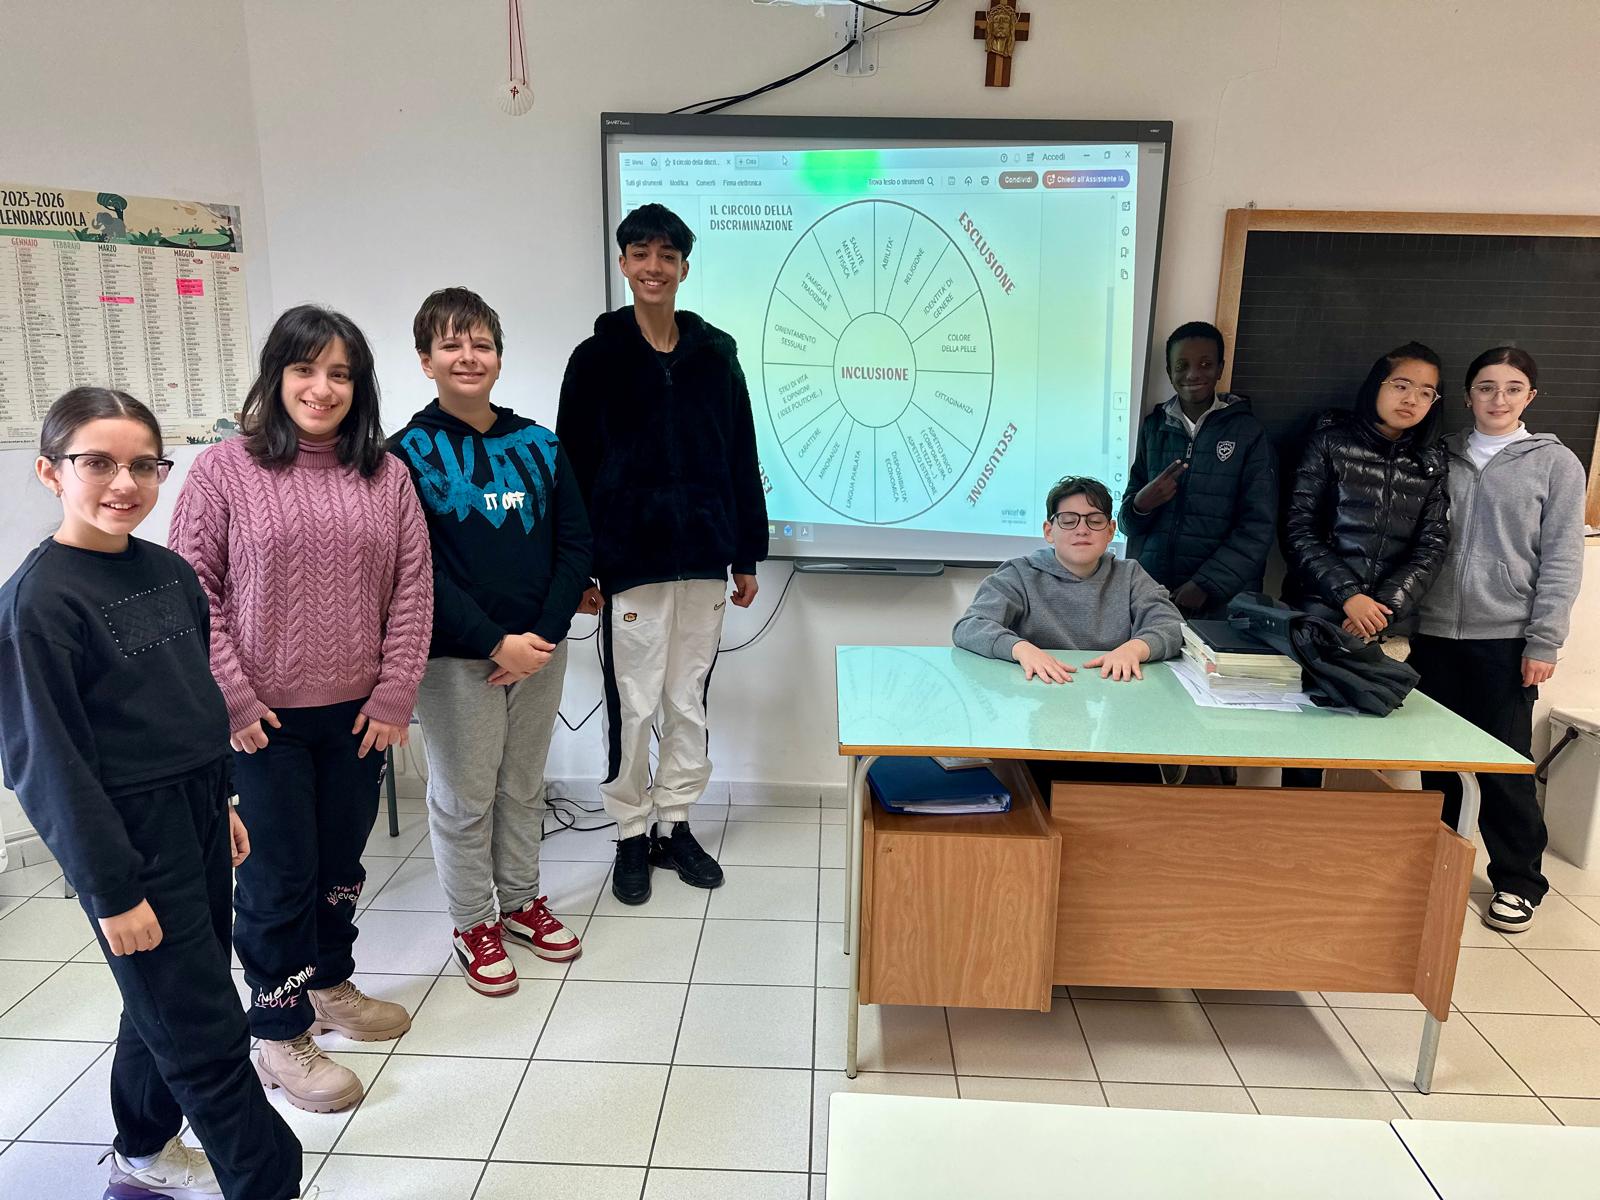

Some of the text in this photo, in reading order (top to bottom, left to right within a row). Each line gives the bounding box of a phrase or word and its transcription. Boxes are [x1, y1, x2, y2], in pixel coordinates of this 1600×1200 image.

[1042, 152, 1066, 162] Accedi
[1004, 175, 1033, 184] Condividi
[1057, 174, 1124, 184] Chiedi all'Assistente IA
[1, 190, 64, 208] 2025-2026
[710, 204, 793, 216] IL CIRCOLO DELLA
[0, 209, 87, 226] LENDARSCUOLA
[710, 220, 793, 232] DISCRIMINAZIONE
[12, 238, 38, 248] GENNAIO
[52, 240, 81, 250] FEBBRAIO
[98, 244, 117, 253] MARZO
[138, 247, 156, 255] APRILE
[174, 250, 195, 258] MAGGIO
[849, 236, 864, 266] SALUTE
[882, 236, 894, 270] ABILITA'
[958, 211, 1016, 296] ESCLUSIONE
[210, 252, 231, 260] GIUGNO
[838, 254, 850, 279] FISICA
[841, 240, 860, 276] MENTALE
[904, 248, 925, 286] RELIGIONE
[805, 272, 829, 298] FAMIGLIA
[801, 281, 828, 312] TRADIZIONI
[924, 278, 954, 316] IDENTITA' DI
[933, 294, 954, 319] GENERE
[774, 324, 816, 344] ORIENTAMENTO
[781, 337, 807, 352] SESSUALE
[948, 334, 971, 342] COLORE
[778, 383, 791, 395] STILI
[796, 373, 808, 386] VITA
[841, 366, 909, 381] INCLUSIONE
[786, 384, 810, 402] OPINIONI
[934, 390, 974, 416] CITTADINANZA
[798, 427, 822, 459] CARATTERE
[928, 426, 952, 474] ASPETTO FISICO
[818, 442, 840, 480] MINORANZE
[907, 436, 938, 496] ASPETTO ESTERIORE
[966, 422, 1018, 507] ESCLUSIONE
[846, 450, 862, 508] LINGUA PARLATA
[885, 458, 900, 503] ECONOMICA
[891, 451, 908, 503] DISPONIBILITA'
[483, 490, 526, 511] IT OFF
